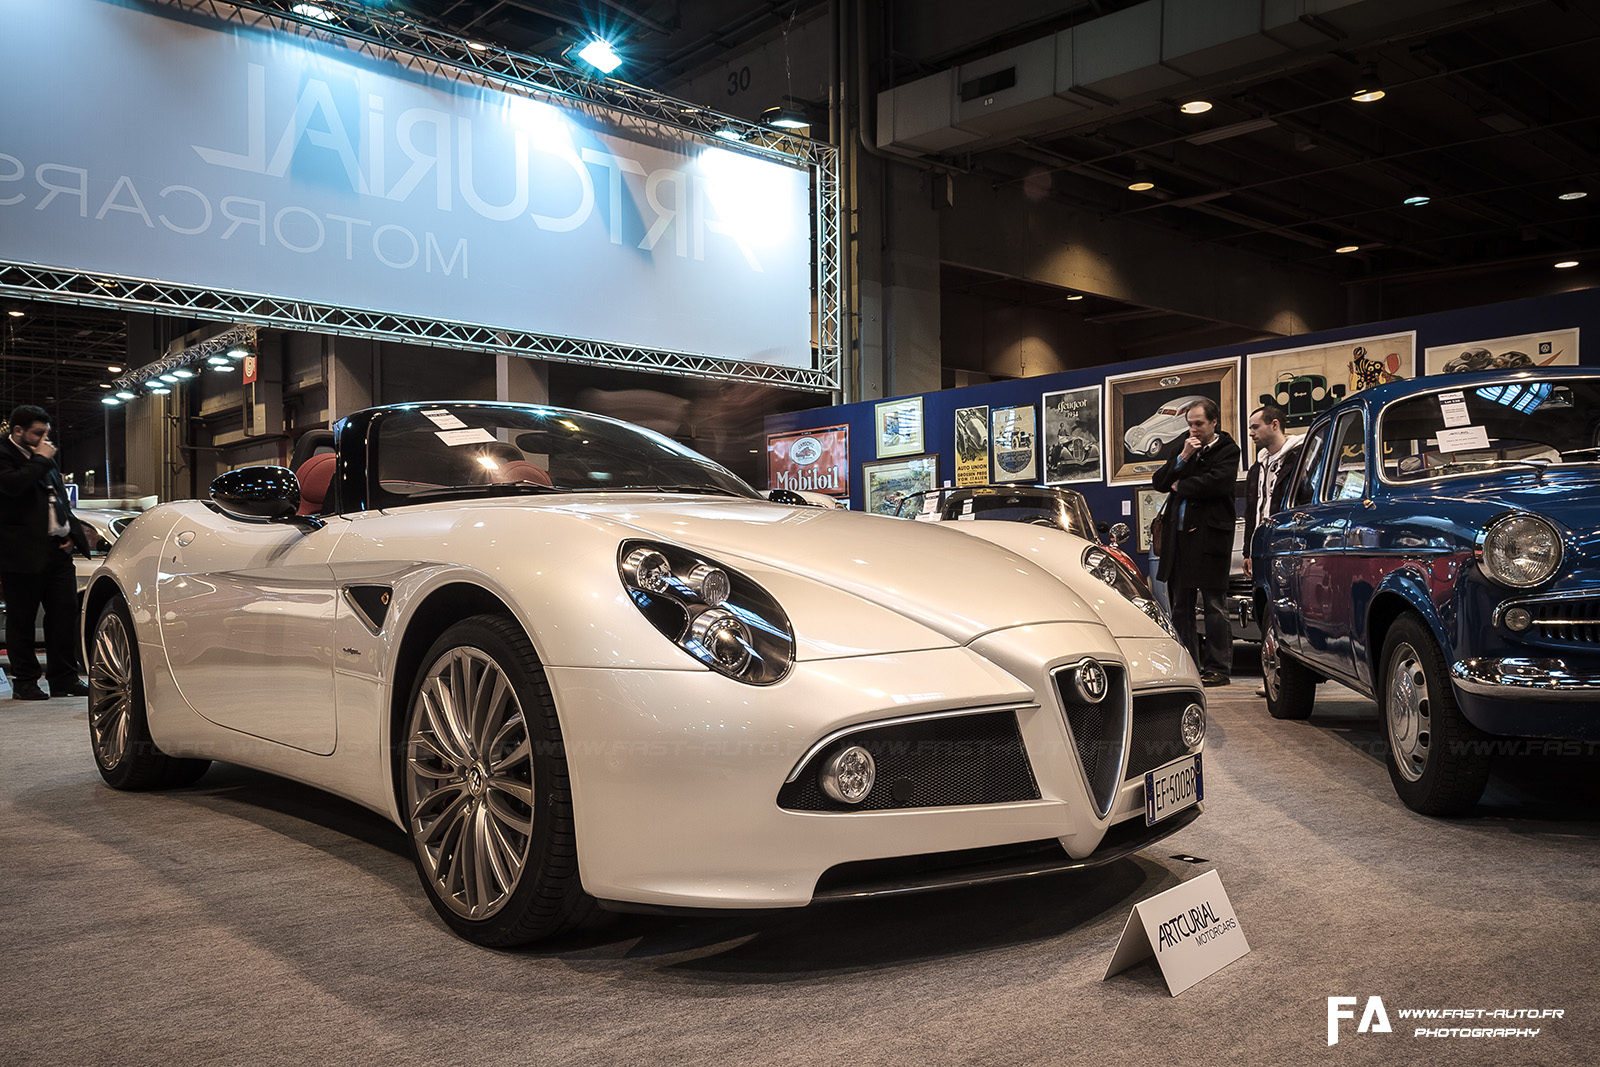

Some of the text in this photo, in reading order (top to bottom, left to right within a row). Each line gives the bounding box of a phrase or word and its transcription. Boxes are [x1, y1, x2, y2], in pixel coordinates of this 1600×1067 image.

[727, 66, 750, 96] 30
[776, 465, 839, 491] Mobiloil
[1195, 918, 1236, 946] MOTORCARS
